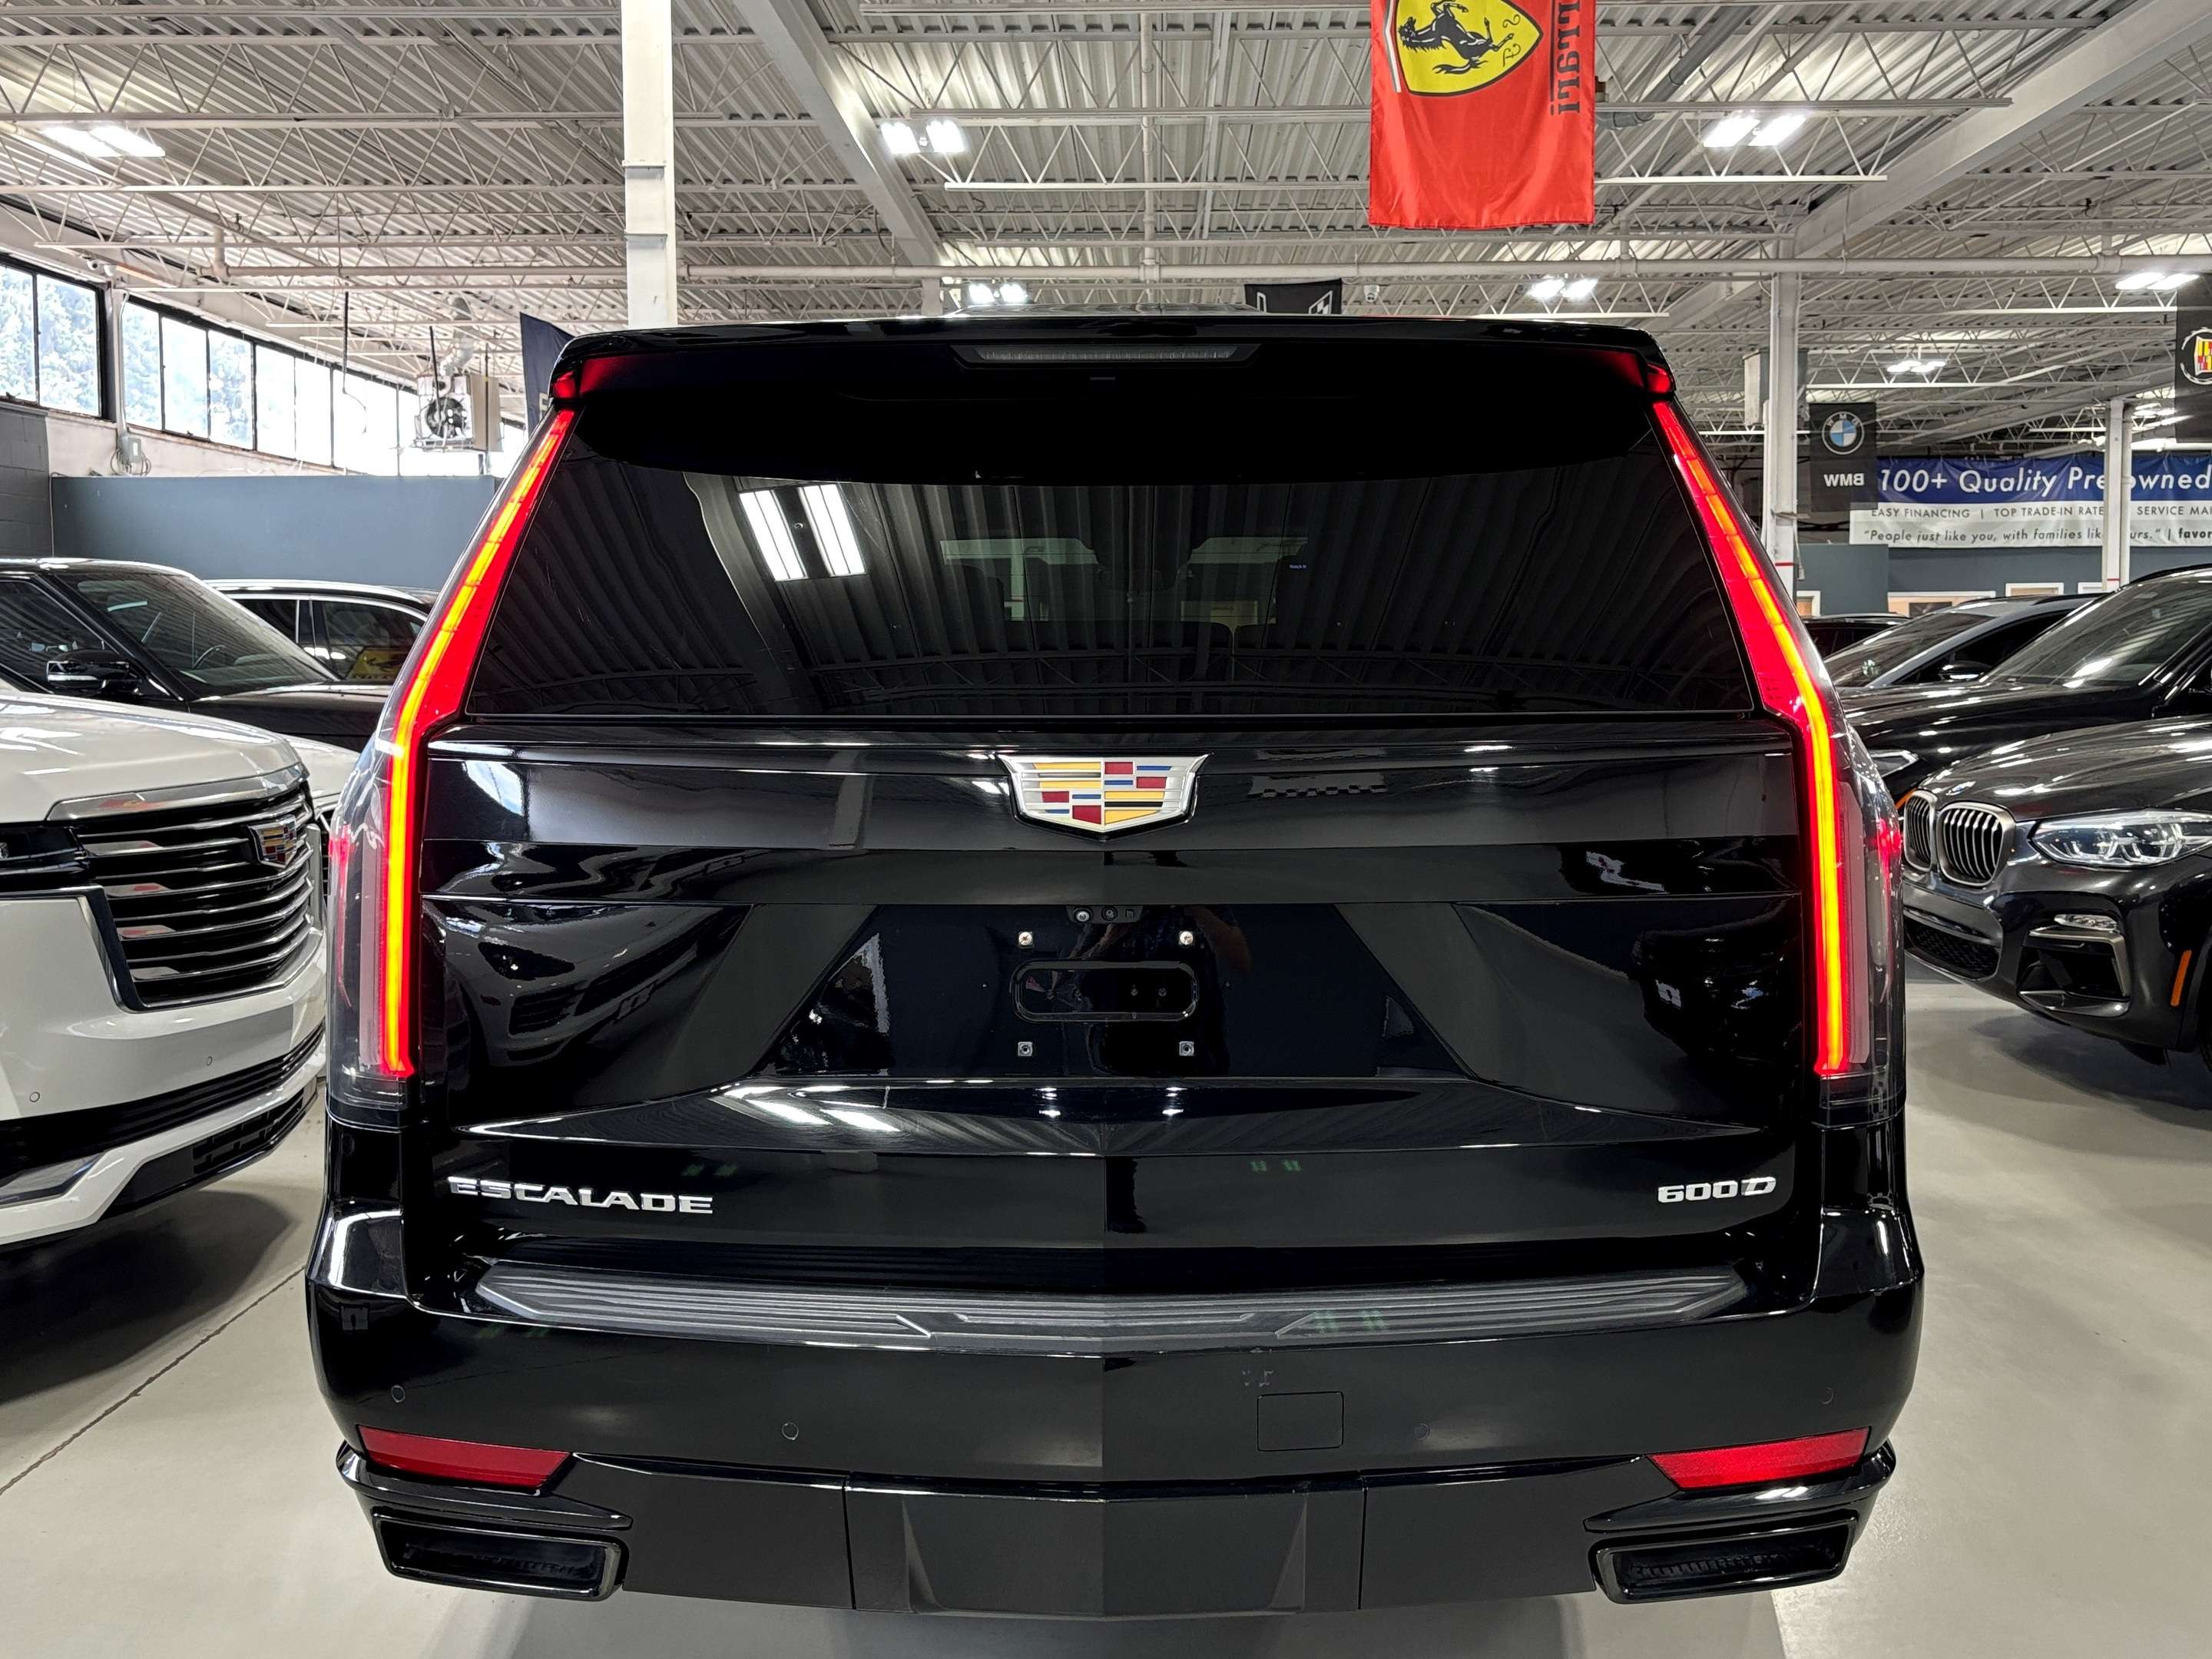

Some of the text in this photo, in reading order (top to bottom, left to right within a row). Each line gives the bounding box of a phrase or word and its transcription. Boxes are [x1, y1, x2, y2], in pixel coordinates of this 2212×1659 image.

[1881, 469, 1948, 492] 100+
[1959, 467, 2057, 497] Quality
[1872, 508, 1900, 517] EASY
[1904, 508, 1970, 518] FINANCING
[1994, 508, 2017, 517] TOP
[2022, 506, 2073, 515] TRADE-IN
[2137, 506, 2184, 515] SERVICE
[1916, 530, 1940, 542] just
[1945, 529, 1966, 541] like
[1972, 533, 1996, 544] you,
[2003, 529, 2028, 540] with
[2034, 528, 2082, 540] families
[448, 1176, 714, 1214] ESCALADE
